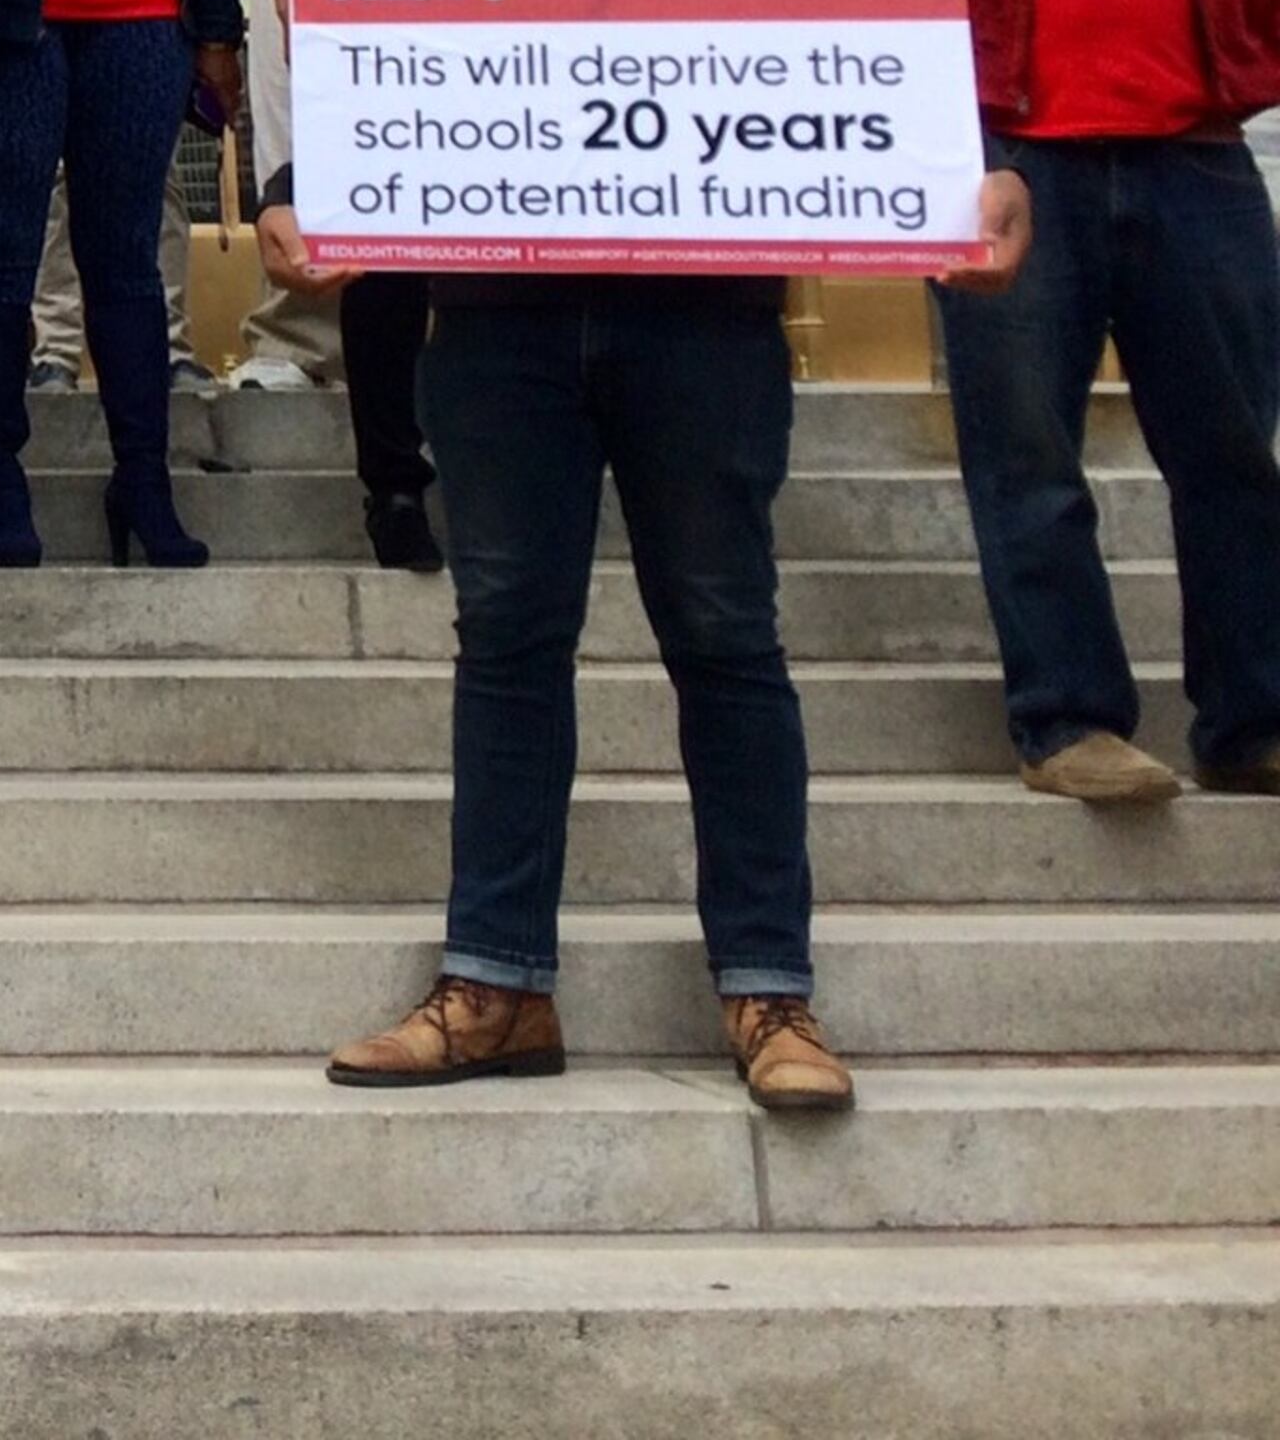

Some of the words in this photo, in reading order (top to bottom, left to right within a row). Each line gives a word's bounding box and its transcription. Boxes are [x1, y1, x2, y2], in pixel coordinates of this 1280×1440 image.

[338, 44, 446, 87] This
[465, 43, 550, 87] will
[569, 43, 789, 96] deprive
[808, 44, 905, 87] the
[353, 107, 563, 152] schools
[581, 99, 668, 152] 20
[692, 110, 894, 164] years
[348, 173, 403, 215] of
[421, 173, 680, 225] potential
[699, 173, 928, 230] funding
